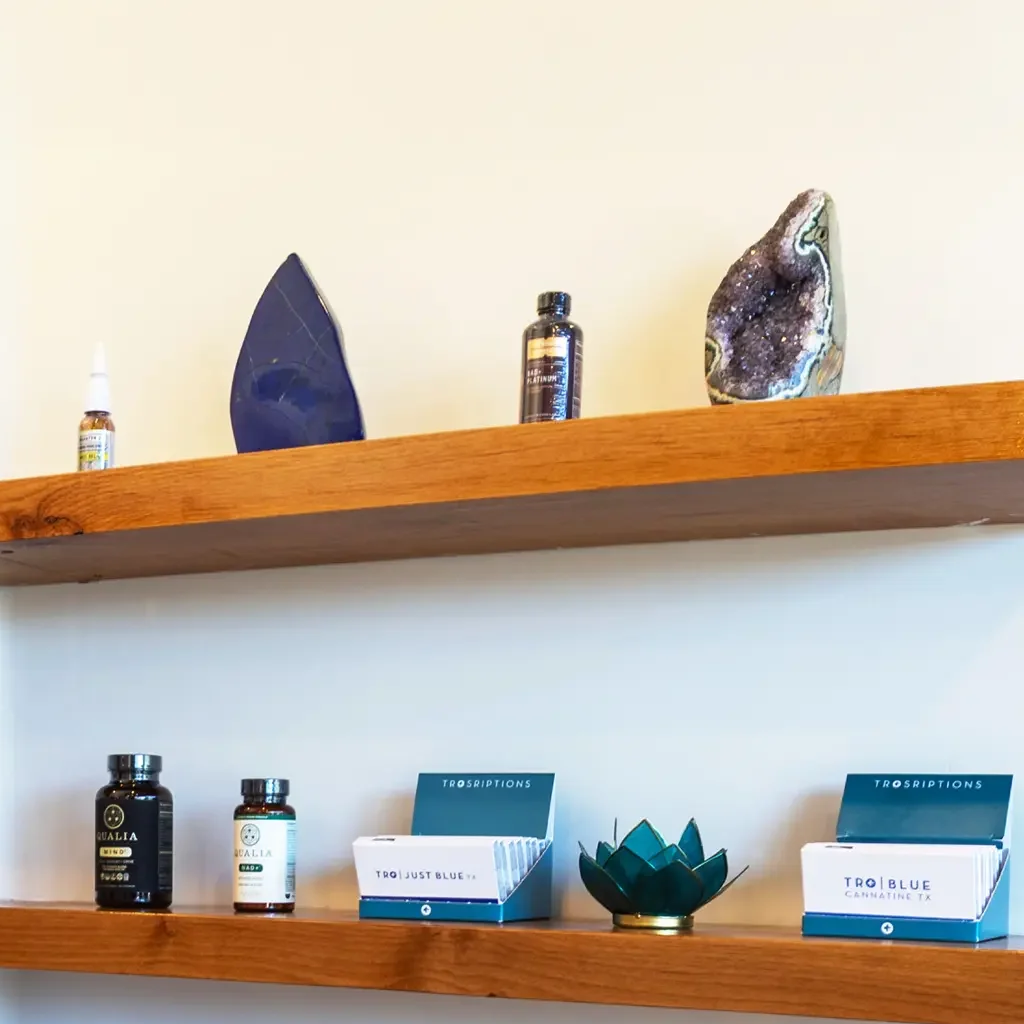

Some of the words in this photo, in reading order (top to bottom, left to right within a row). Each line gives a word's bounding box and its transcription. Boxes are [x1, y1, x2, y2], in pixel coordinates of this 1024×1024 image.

[97, 832, 138, 841] QUALIA
[436, 872, 464, 880] BLUE
[888, 880, 931, 891] BLUE
[845, 890, 911, 901] CANNATINE
[918, 893, 931, 901] TX
